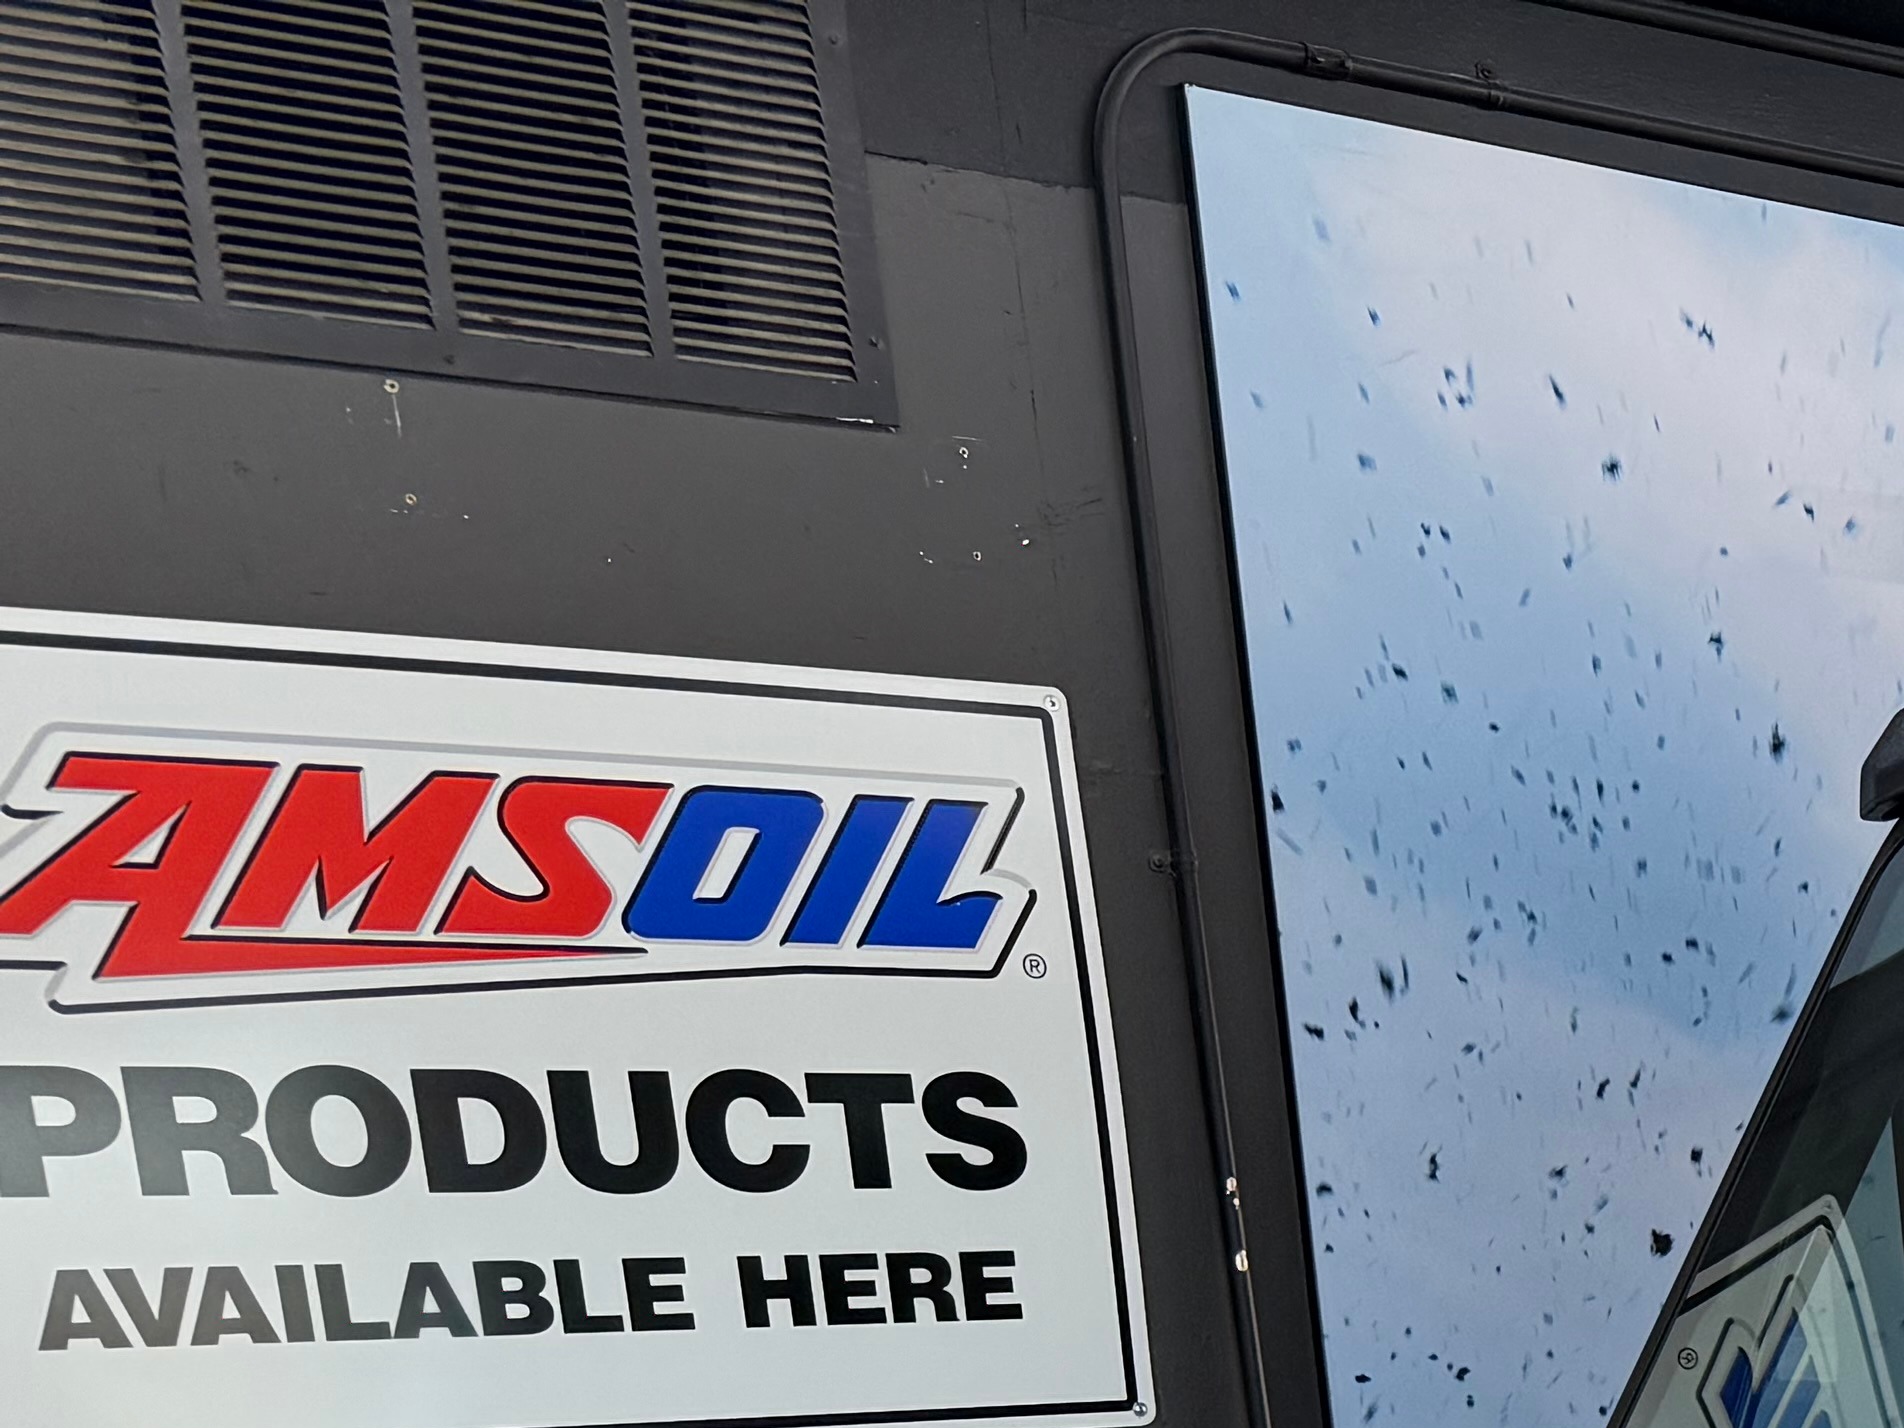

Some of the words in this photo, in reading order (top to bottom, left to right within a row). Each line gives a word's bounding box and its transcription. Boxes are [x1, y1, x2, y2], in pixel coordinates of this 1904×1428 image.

[0, 752, 1026, 978] AMSOIL
[0, 1063, 1029, 1199] PRODUCTS
[37, 1254, 697, 1352] AVAILABLE
[736, 1250, 1025, 1332] HERE
